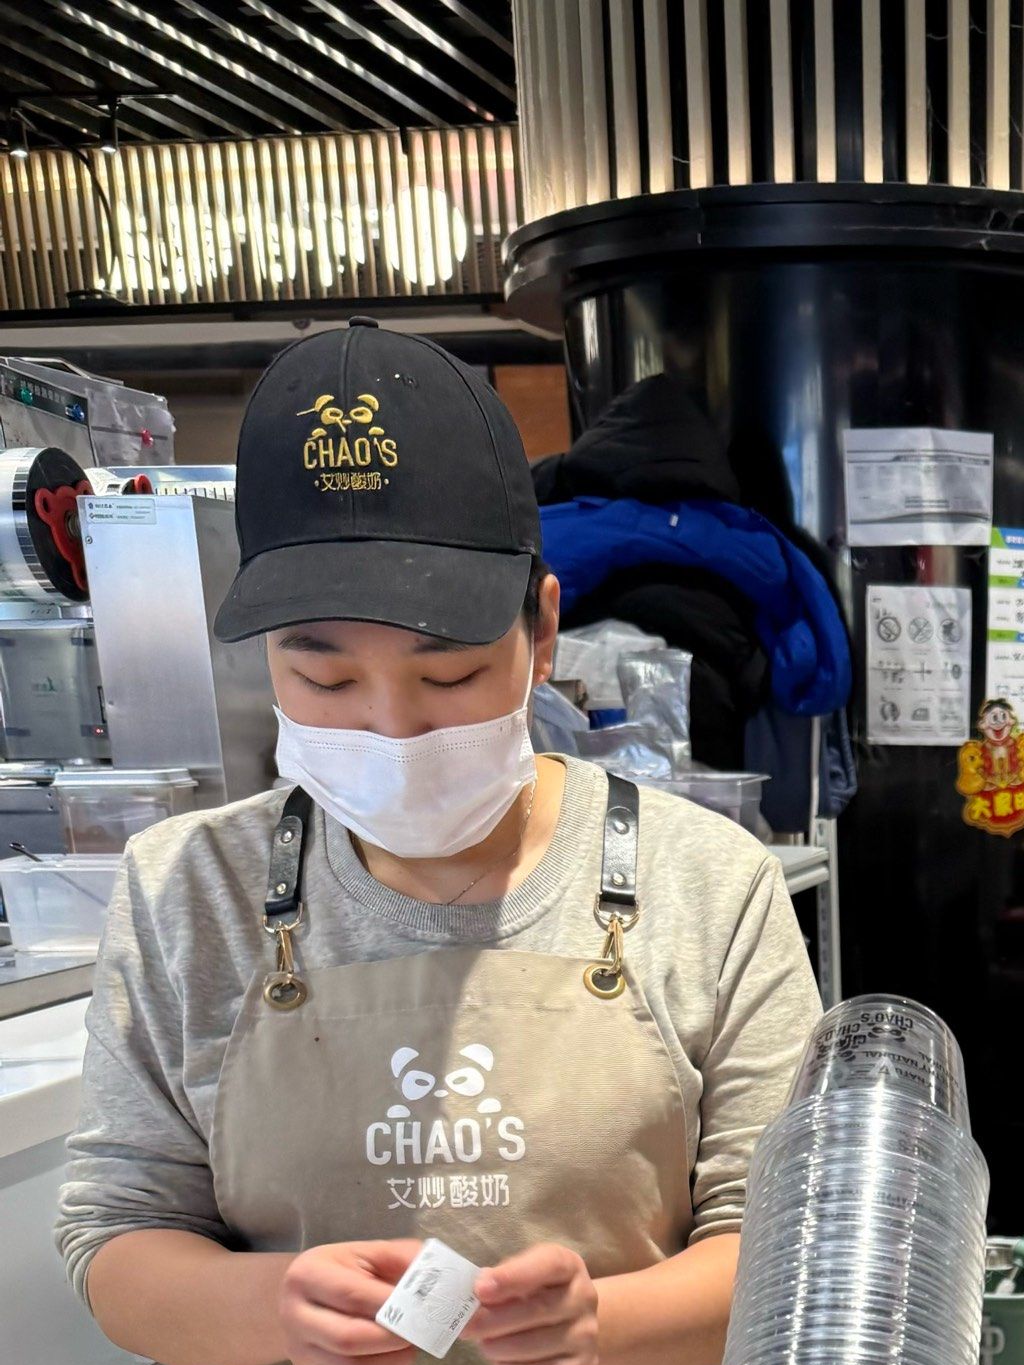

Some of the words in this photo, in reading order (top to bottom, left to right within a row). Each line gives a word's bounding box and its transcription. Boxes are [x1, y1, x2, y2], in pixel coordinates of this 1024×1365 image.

[303, 437, 399, 470] CHAO'S
[860, 1013, 914, 1030] CHAO'S
[365, 1116, 527, 1166] CHAO'S
[386, 1174, 511, 1210] 艾炒酸奶
